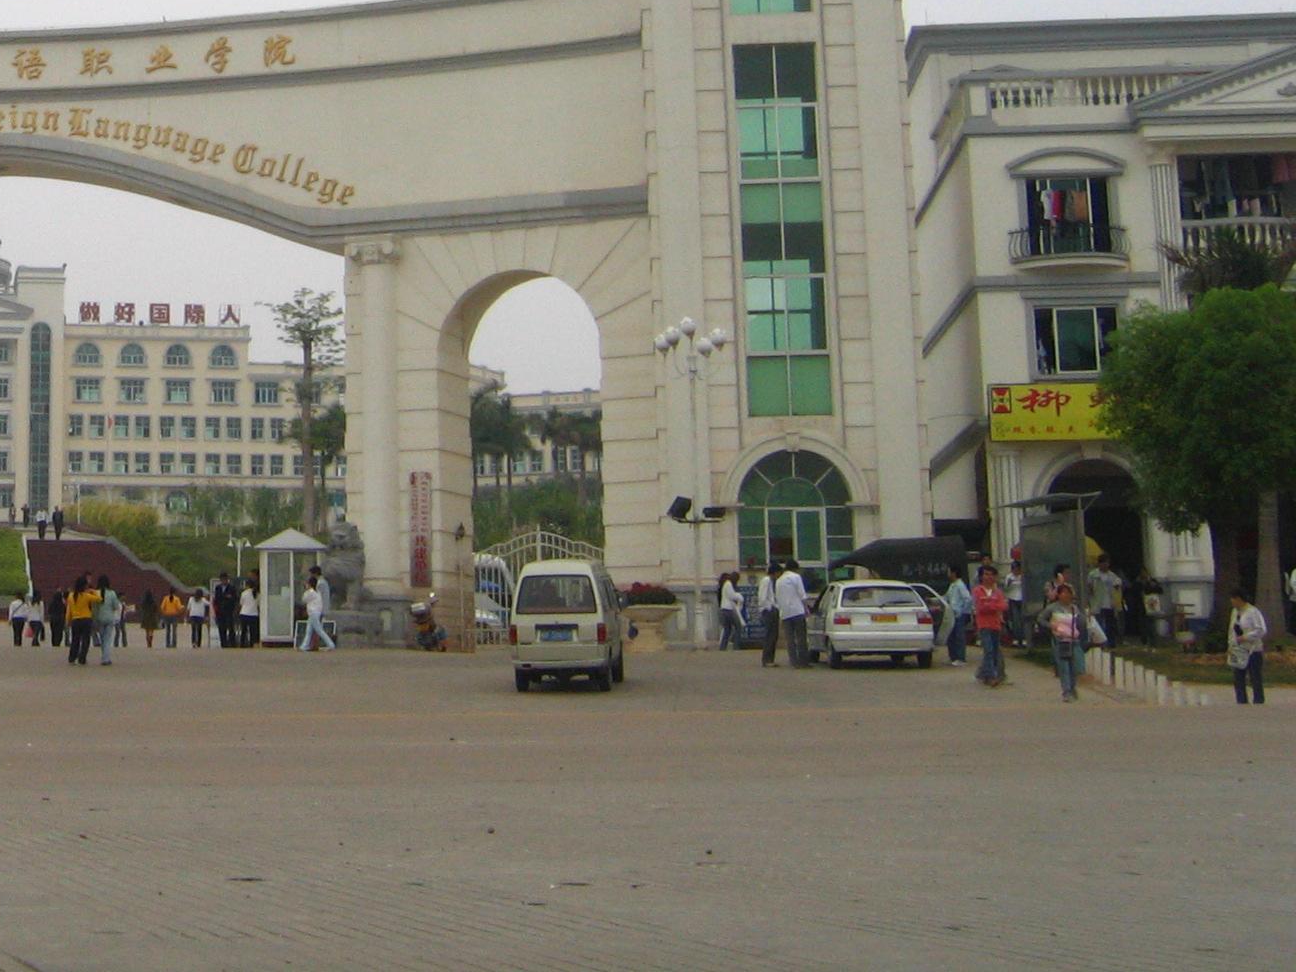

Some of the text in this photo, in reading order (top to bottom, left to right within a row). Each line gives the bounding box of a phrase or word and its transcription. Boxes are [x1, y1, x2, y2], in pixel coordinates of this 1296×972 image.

[69, 106, 226, 164] Language
[233, 142, 355, 207] College
[79, 301, 241, 325] 做好国际人
